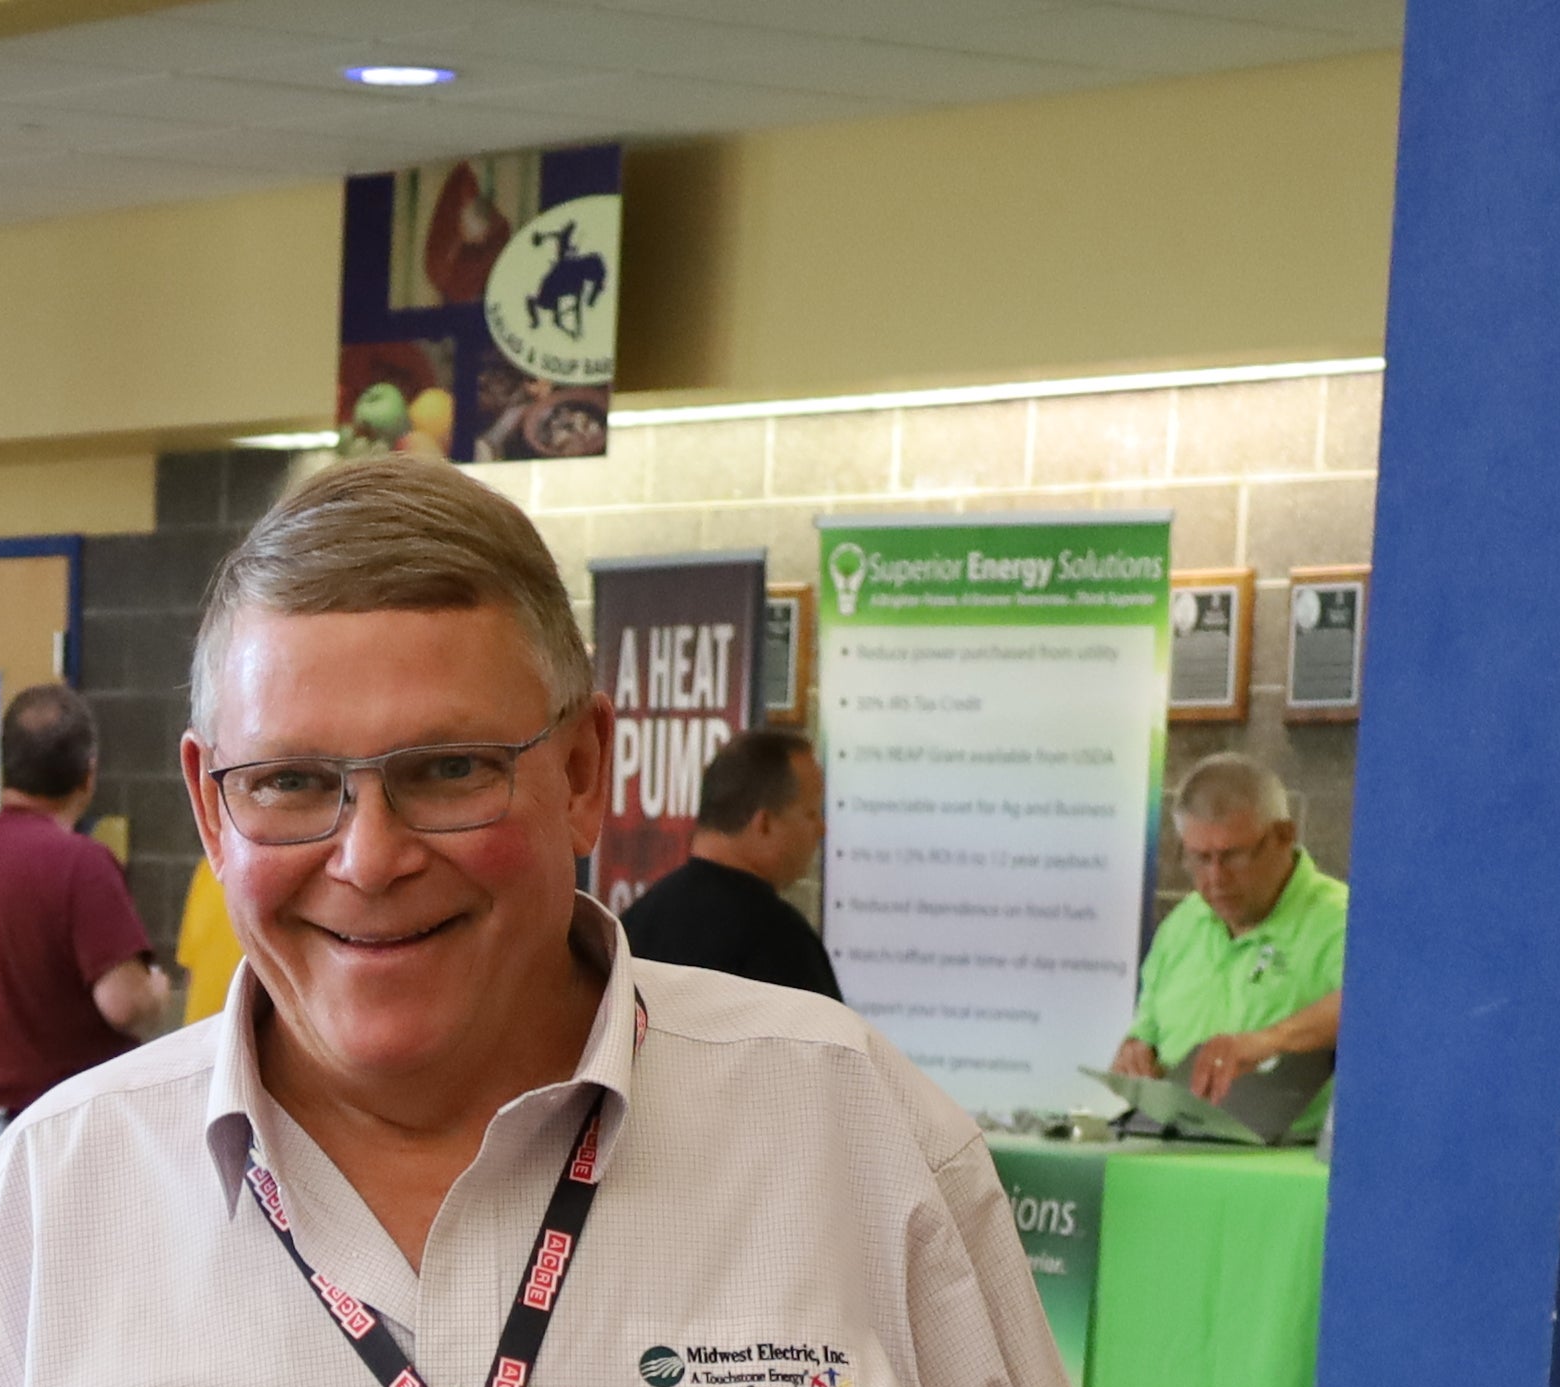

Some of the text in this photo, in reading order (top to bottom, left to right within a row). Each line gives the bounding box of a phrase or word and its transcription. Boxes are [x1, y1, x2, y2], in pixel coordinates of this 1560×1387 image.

[868, 550, 1163, 588] Superior Energy Solutions
[614, 623, 734, 710] A HEAT
[526, 1233, 568, 1306] ACRE
[687, 1344, 849, 1365] Midwest Electric, Inc.
[691, 1371, 701, 1383] A
[703, 1371, 765, 1385] Touchstone
